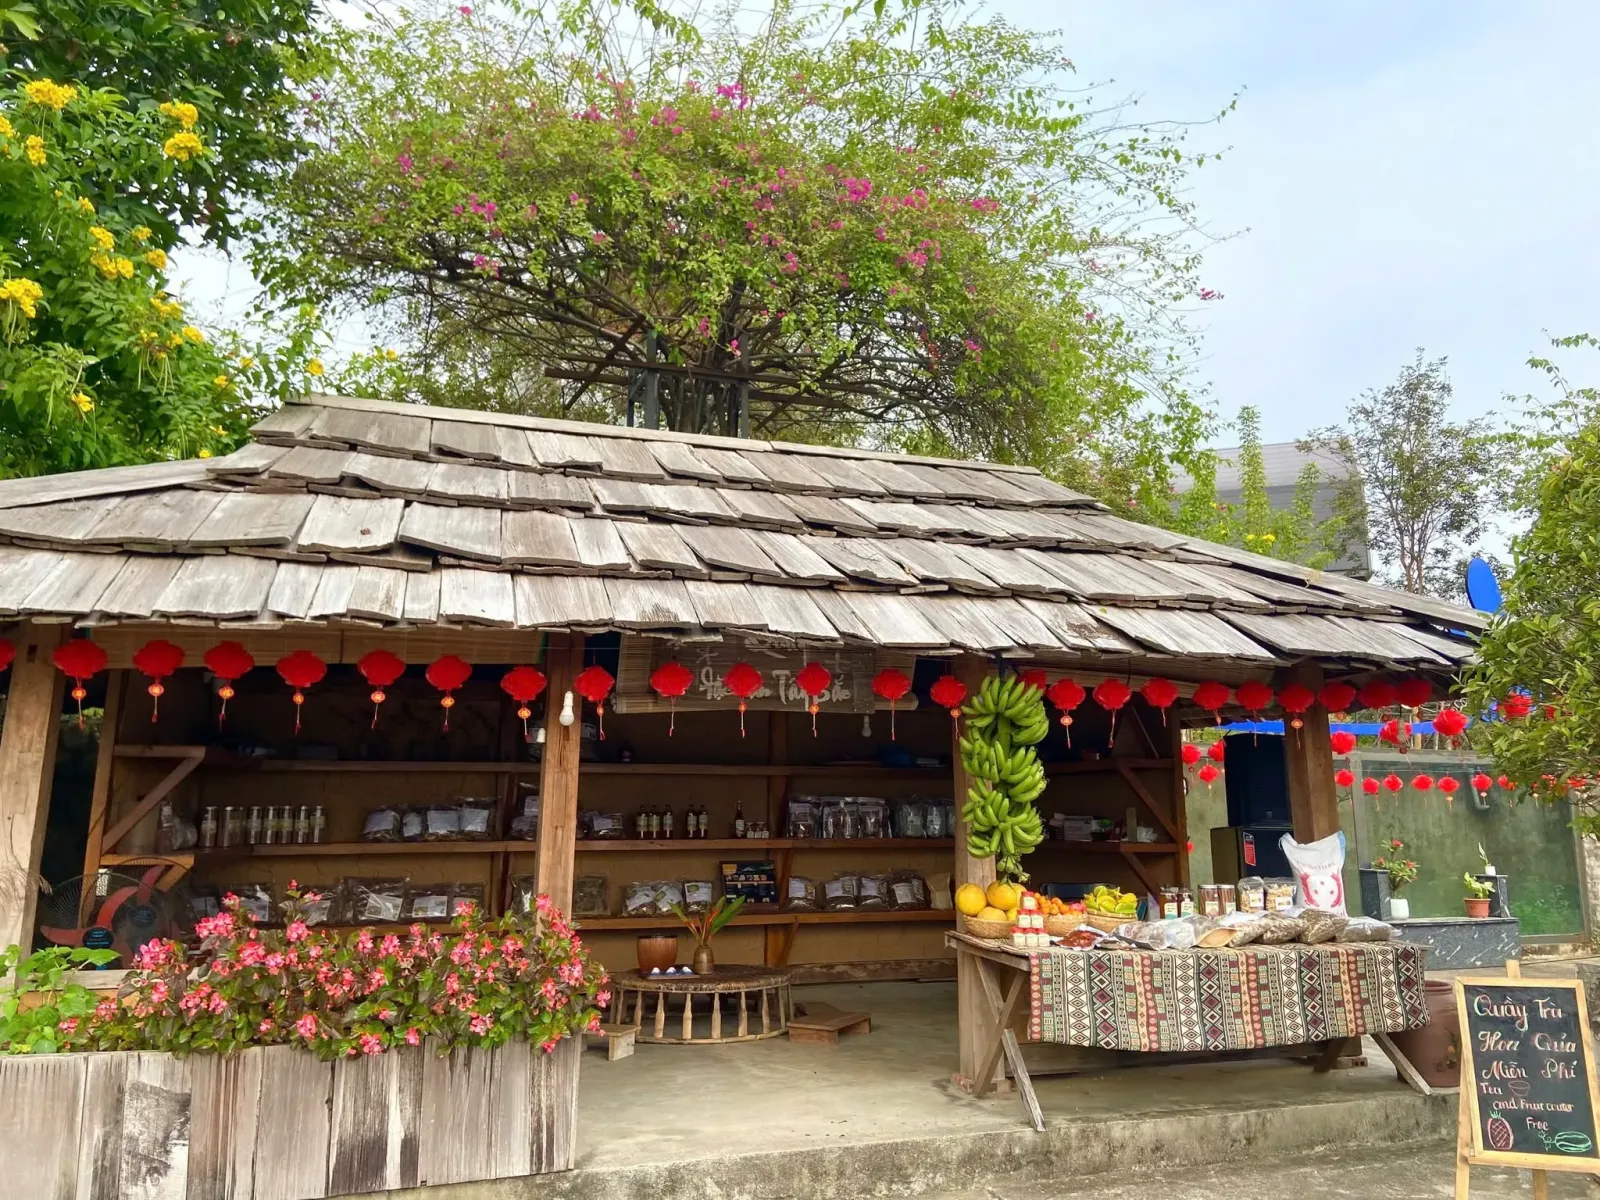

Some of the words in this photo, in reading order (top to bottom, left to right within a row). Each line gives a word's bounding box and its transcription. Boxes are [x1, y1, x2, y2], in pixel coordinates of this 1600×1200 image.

[1474, 994, 1528, 1031] Quầy
[1533, 997, 1562, 1019] Trà
[1478, 1031, 1520, 1052] Hoa
[1534, 1033, 1576, 1053] Quả
[1482, 1061, 1528, 1080] Miễn
[1541, 1058, 1577, 1079] Phí
[1480, 1082, 1503, 1095] Tea
[1493, 1098, 1518, 1110] and
[1526, 1116, 1549, 1130] Free
